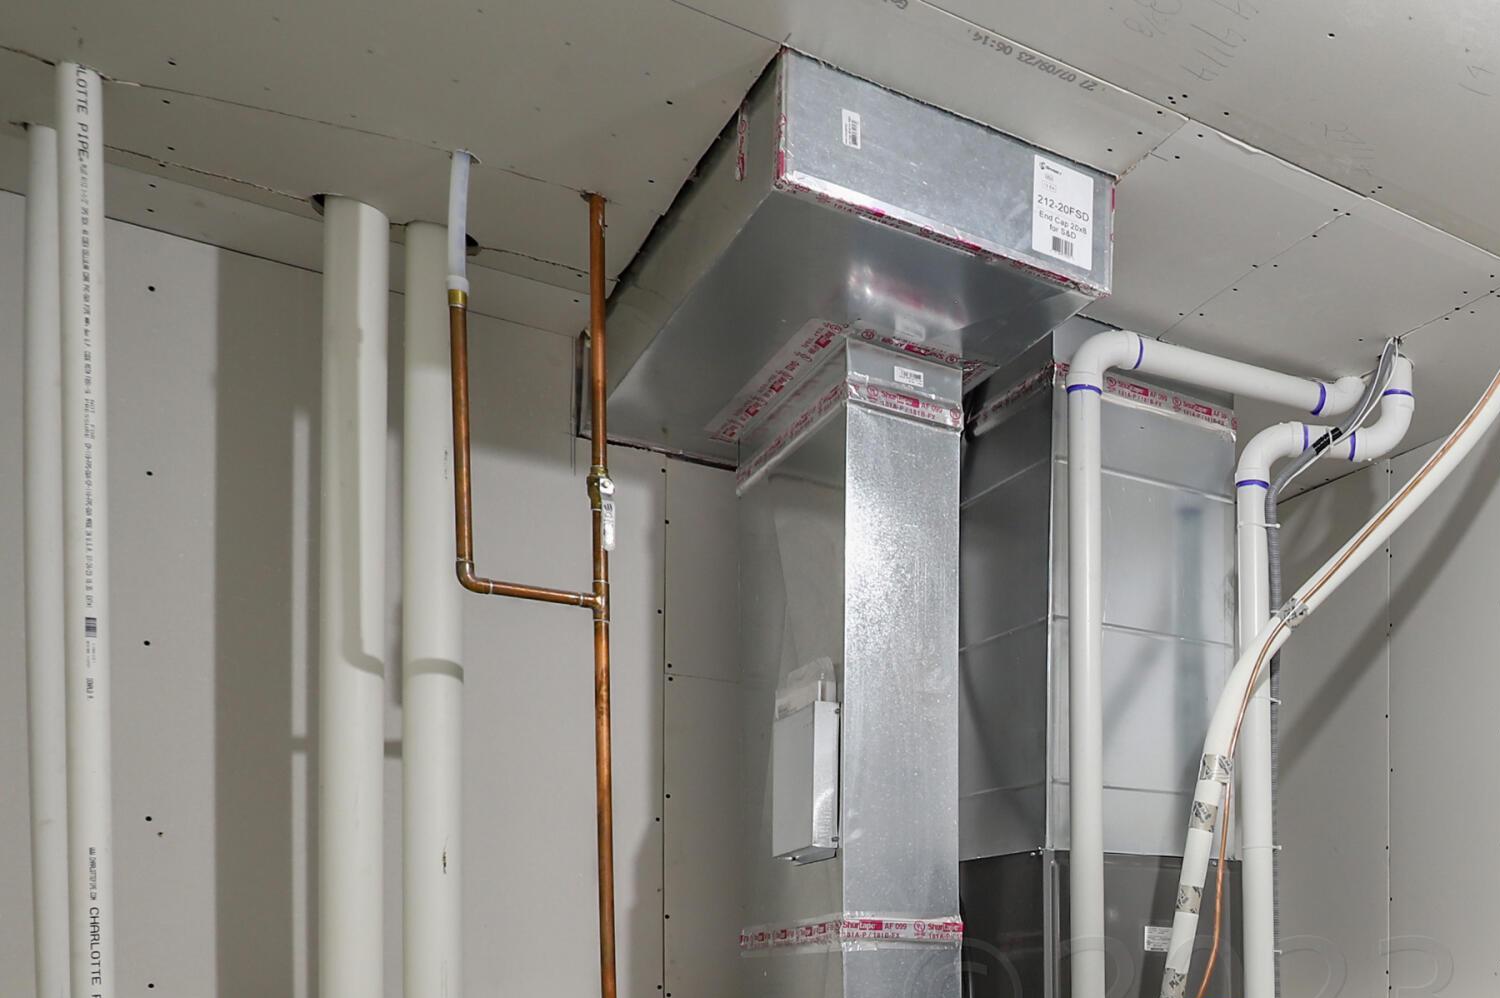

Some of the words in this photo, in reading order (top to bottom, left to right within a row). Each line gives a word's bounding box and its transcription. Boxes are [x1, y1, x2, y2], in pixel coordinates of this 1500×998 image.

[1037, 194, 1090, 222] 212-20FSD
[1039, 210, 1053, 222] End
[1054, 215, 1069, 228] Cap
[1049, 223, 1059, 233] for
[1060, 228, 1077, 240] S&D
[89, 906, 102, 986] CHARLOTTE
